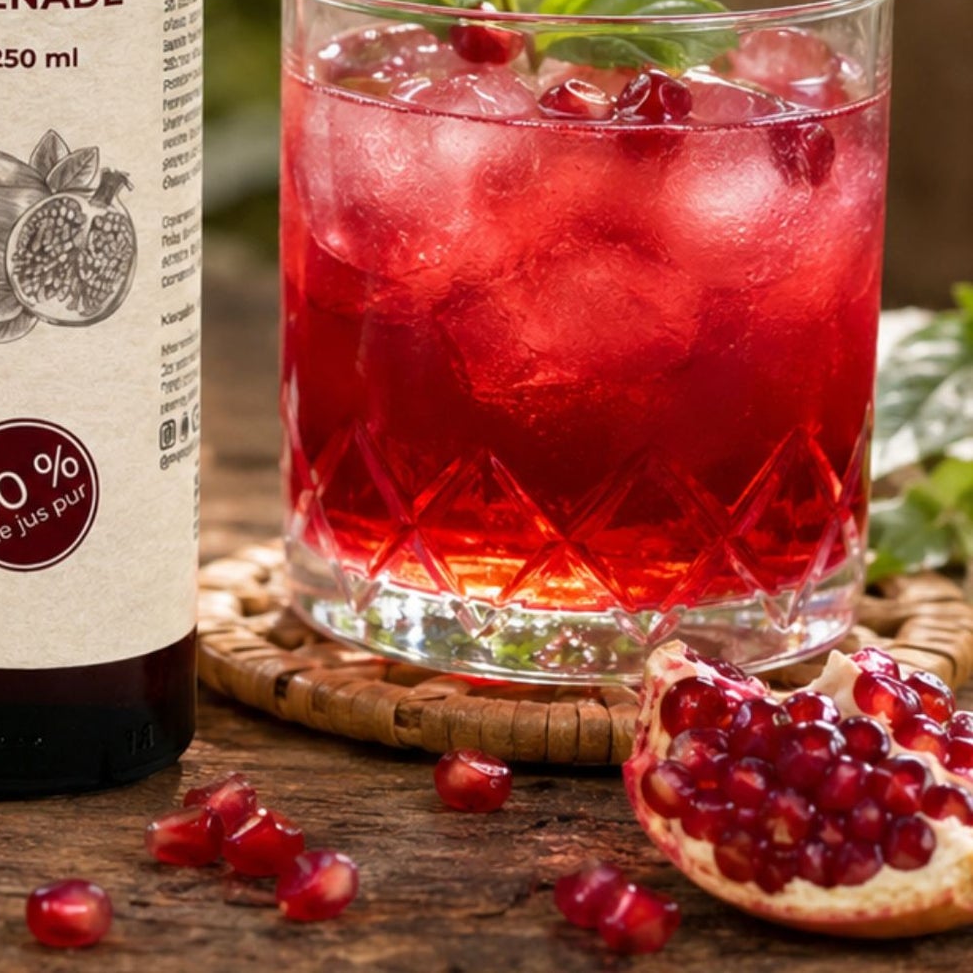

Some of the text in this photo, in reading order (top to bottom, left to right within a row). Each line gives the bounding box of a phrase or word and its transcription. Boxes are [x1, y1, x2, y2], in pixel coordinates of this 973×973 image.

[45, 47, 78, 68] ml
[33, 444, 79, 489] %
[15, 507, 50, 537] jus
[52, 483, 86, 517] pur
